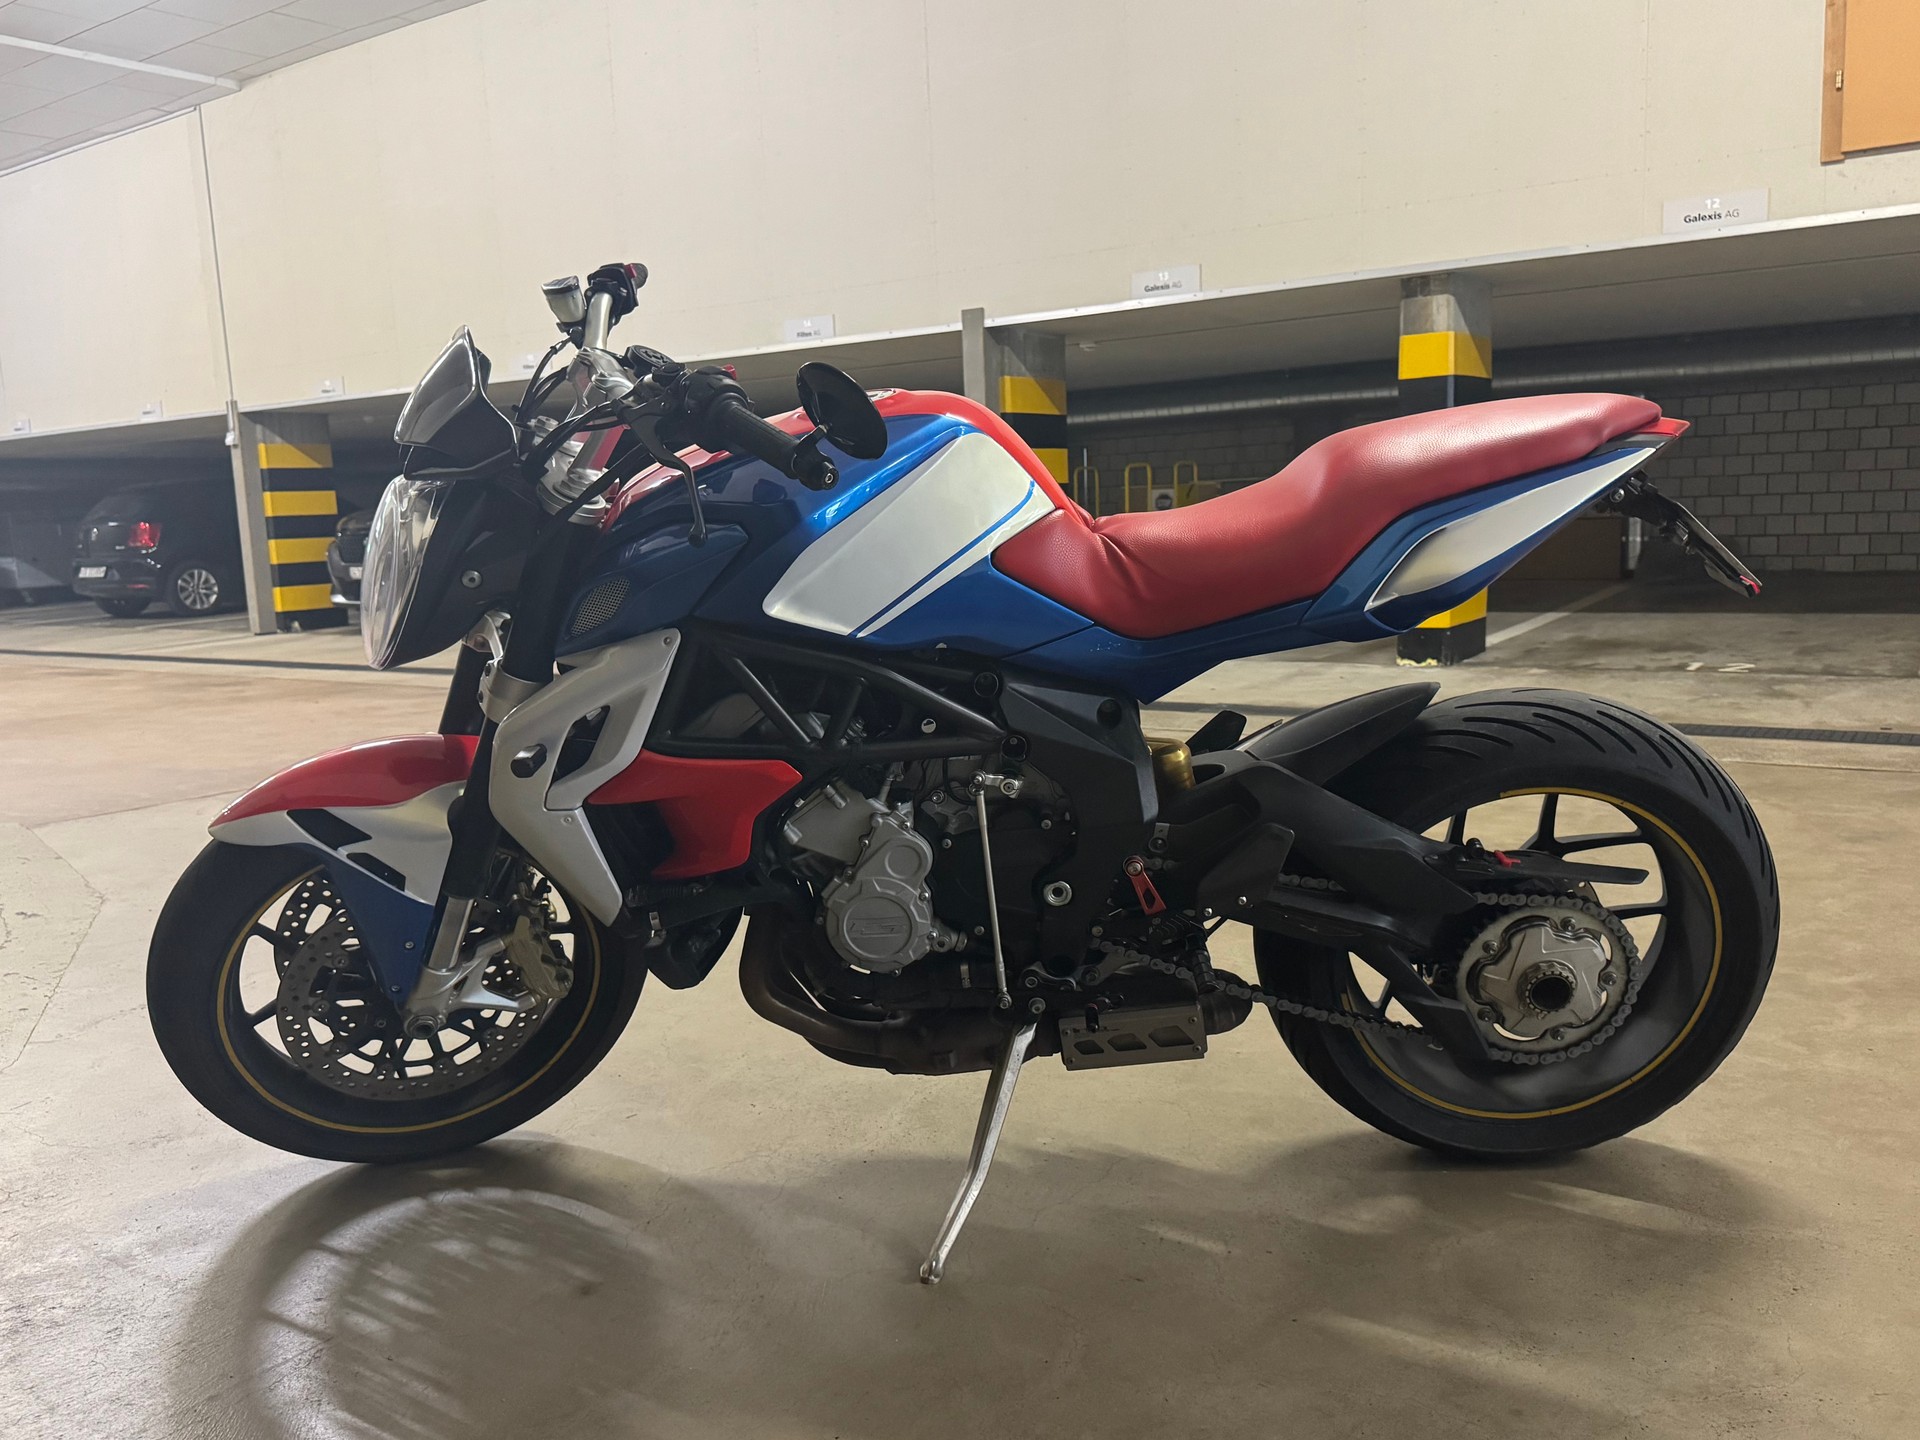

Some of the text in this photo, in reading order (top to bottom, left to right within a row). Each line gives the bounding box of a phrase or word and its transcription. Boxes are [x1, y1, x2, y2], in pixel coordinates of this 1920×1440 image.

[1704, 198, 1721, 209] 12
[1683, 208, 1740, 223] Galexis AG
